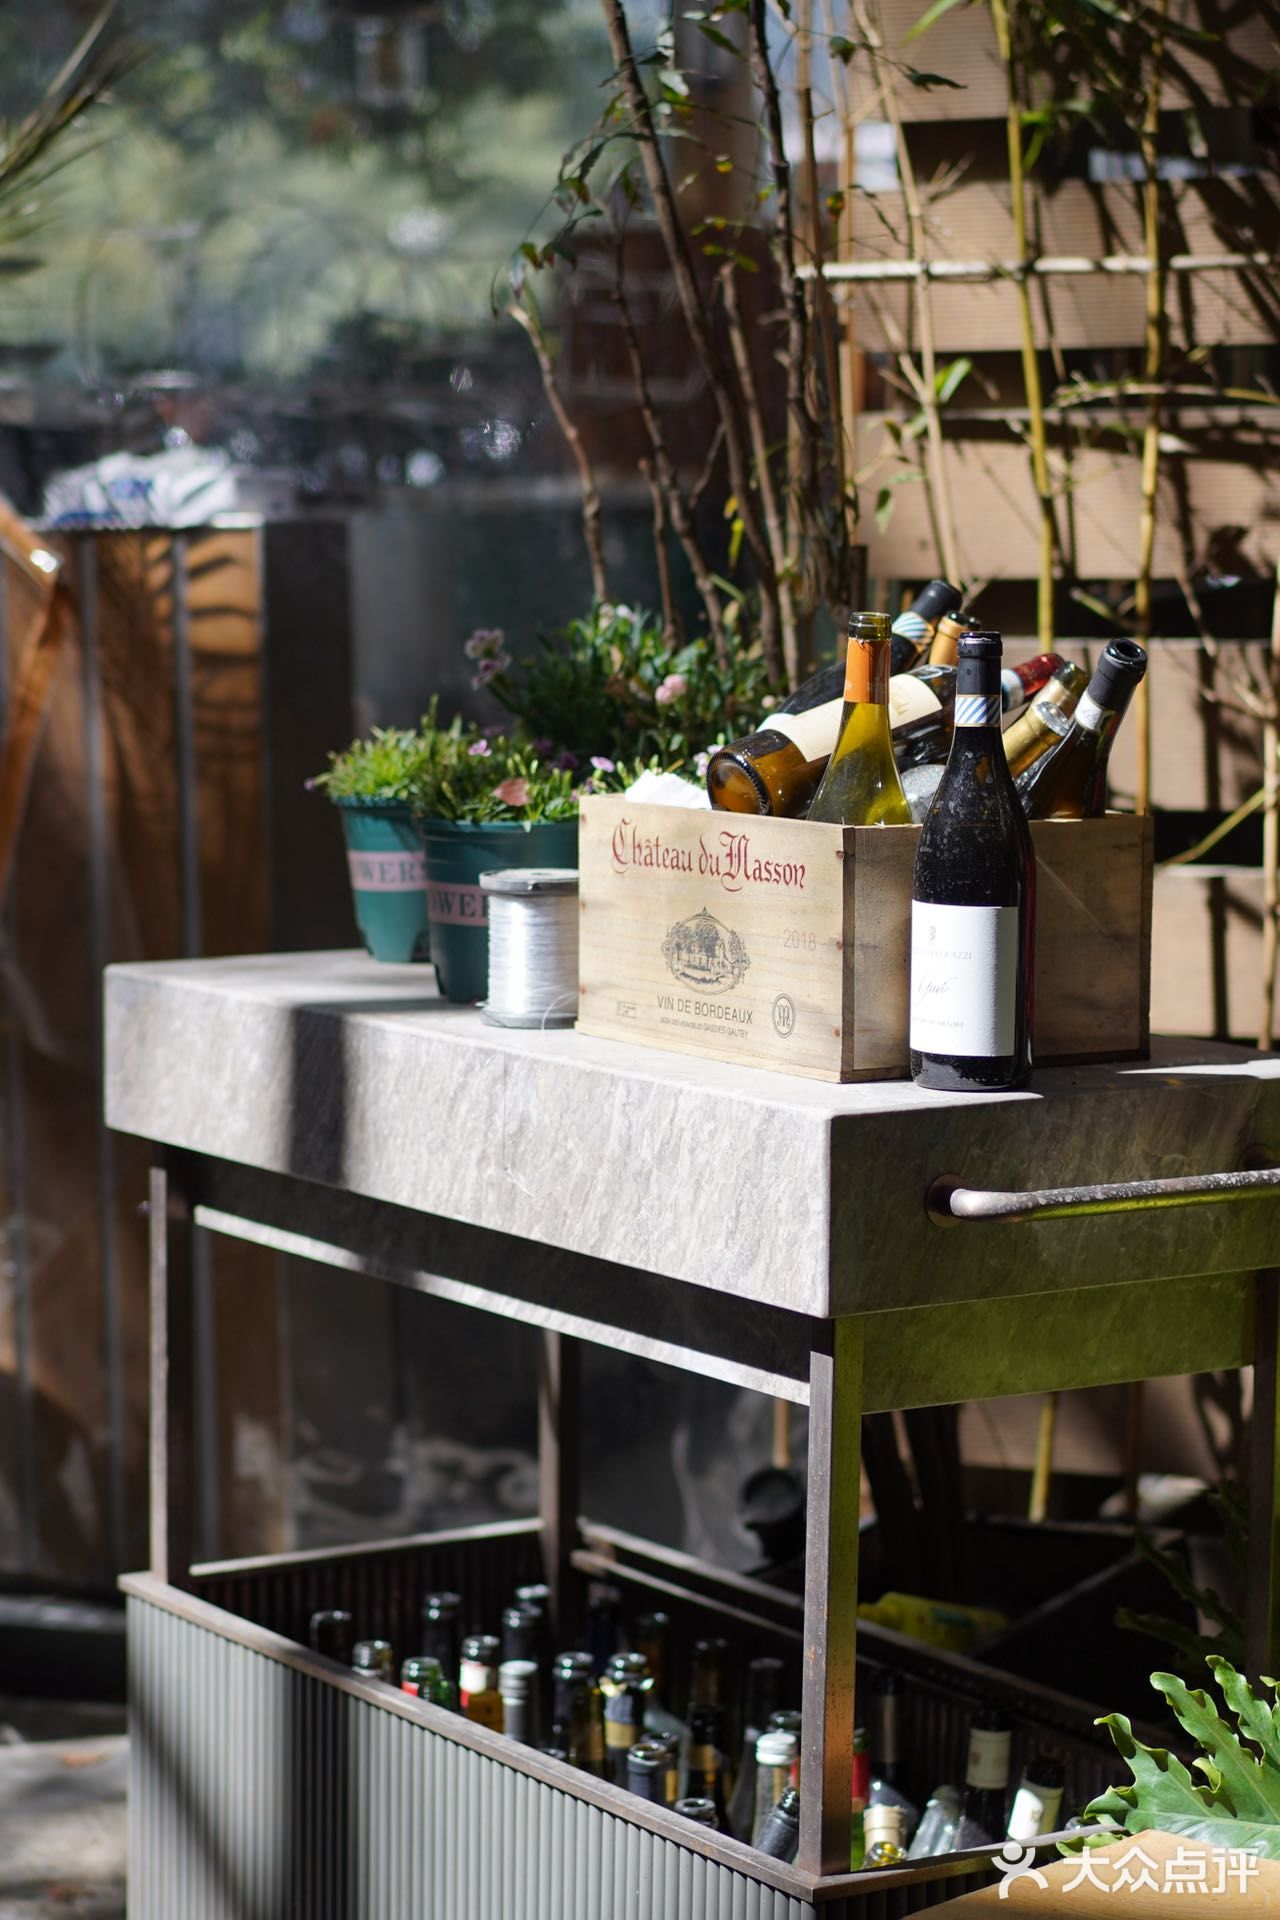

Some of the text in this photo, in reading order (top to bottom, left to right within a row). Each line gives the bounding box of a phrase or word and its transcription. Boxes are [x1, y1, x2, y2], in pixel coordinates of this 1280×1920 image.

[612, 818, 693, 874] Château
[699, 834, 721, 876] du
[783, 928, 816, 951] 2018
[656, 995, 674, 1011] VIN
[677, 998, 691, 1014] DE
[694, 1001, 753, 1024] BORDEAUX
